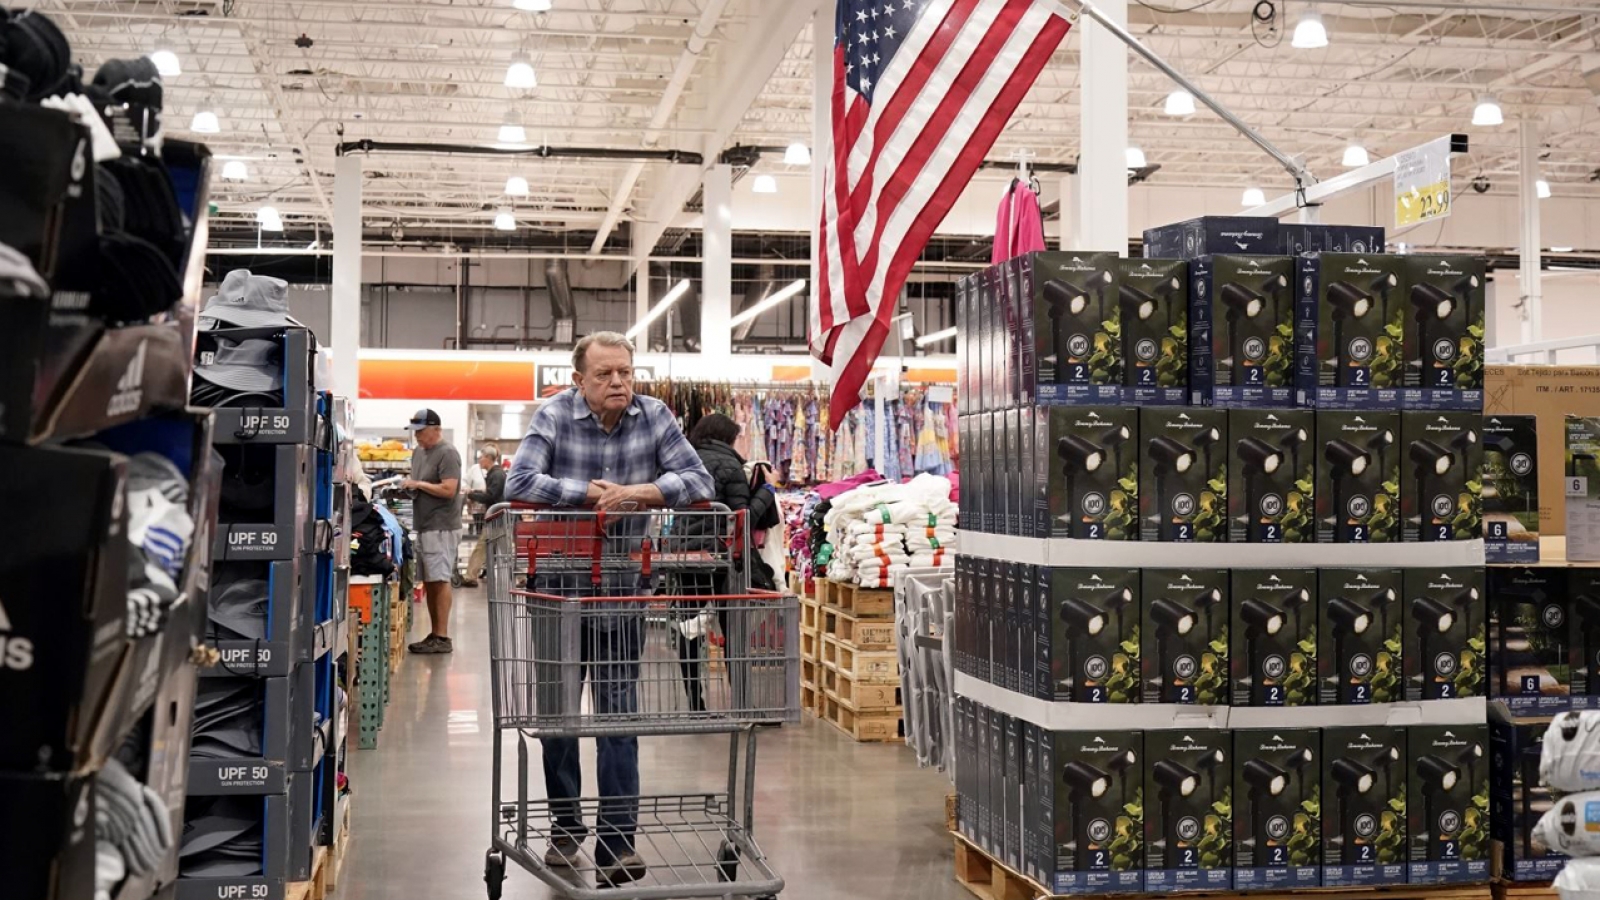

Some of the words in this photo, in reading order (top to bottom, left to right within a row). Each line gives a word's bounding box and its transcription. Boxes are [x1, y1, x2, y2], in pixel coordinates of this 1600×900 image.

[1075, 365, 1084, 379] 2
[1142, 369, 1151, 382] 2
[1250, 368, 1258, 381] 2
[1355, 369, 1364, 382] 2
[1440, 369, 1448, 383] 2
[240, 415, 269, 429] UPF
[273, 415, 290, 429] 50
[1516, 459, 1527, 469] 30
[1573, 479, 1580, 491] 6
[1089, 524, 1098, 538] 2
[1179, 525, 1188, 539] 2
[1267, 525, 1276, 539] 2
[1354, 527, 1363, 540] 2
[1439, 526, 1447, 539] 2
[1494, 524, 1501, 536] 6
[228, 532, 257, 545] UPF
[261, 532, 277, 545] 50
[221, 649, 250, 662] UPF
[257, 648, 271, 662] 50
[1441, 684, 1450, 697] 2
[1527, 677, 1534, 690] 6
[1092, 688, 1101, 702] 2
[1181, 687, 1189, 701] 2
[1270, 687, 1278, 700] 2
[1356, 686, 1365, 699] 2
[218, 767, 248, 780] UPF
[252, 766, 269, 780] 50
[1274, 848, 1282, 862] 2
[1361, 845, 1370, 859] 2
[1446, 842, 1454, 855] 2
[1095, 851, 1104, 866] 2
[1184, 849, 1193, 863] 2
[218, 885, 247, 899] UPF
[252, 884, 268, 897] 50
